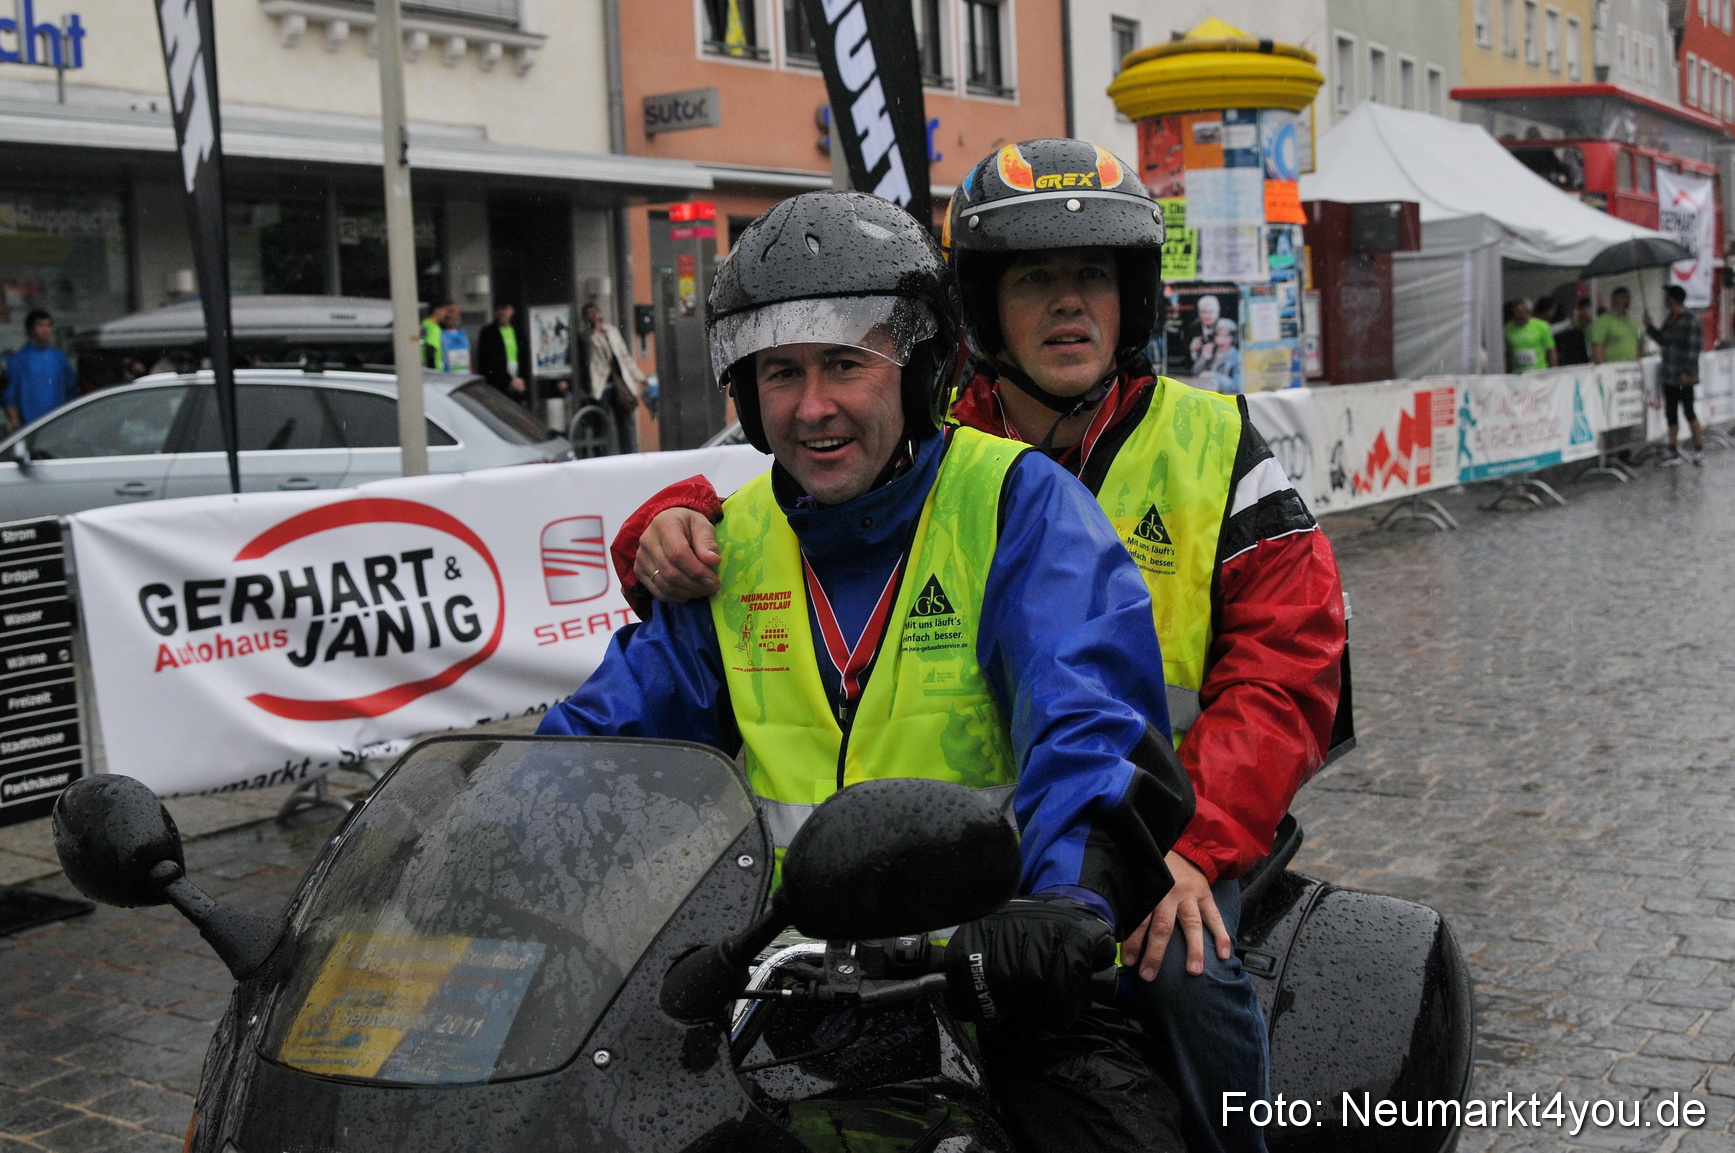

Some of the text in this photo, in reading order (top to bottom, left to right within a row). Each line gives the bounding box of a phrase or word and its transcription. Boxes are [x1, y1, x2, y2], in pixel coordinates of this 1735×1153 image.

[1036, 172, 1096, 189] GREX
[1, 528, 37, 544] Strom
[1127, 537, 1175, 556] Mit uns läuft's
[1150, 556, 1175, 567] besser.
[1, 568, 40, 585] Erdgas
[138, 547, 462, 636] GERHART &
[741, 591, 792, 603] NEUMARKTER
[748, 601, 791, 612] STADTLAUF
[3, 610, 44, 627] Wasser
[533, 607, 633, 646] SEAT
[918, 621, 933, 629] uns
[935, 617, 962, 627] läuft's
[287, 595, 482, 667] JÄNIG
[934, 631, 963, 641] besser.
[154, 628, 289, 673] Autohaus
[6, 653, 48, 670] Wärme
[8, 691, 52, 711] Freizeit
[0, 732, 65, 754] Stadtbusse
[4, 773, 70, 796] Parkhäuser
[968, 952, 988, 991] SHIELD
